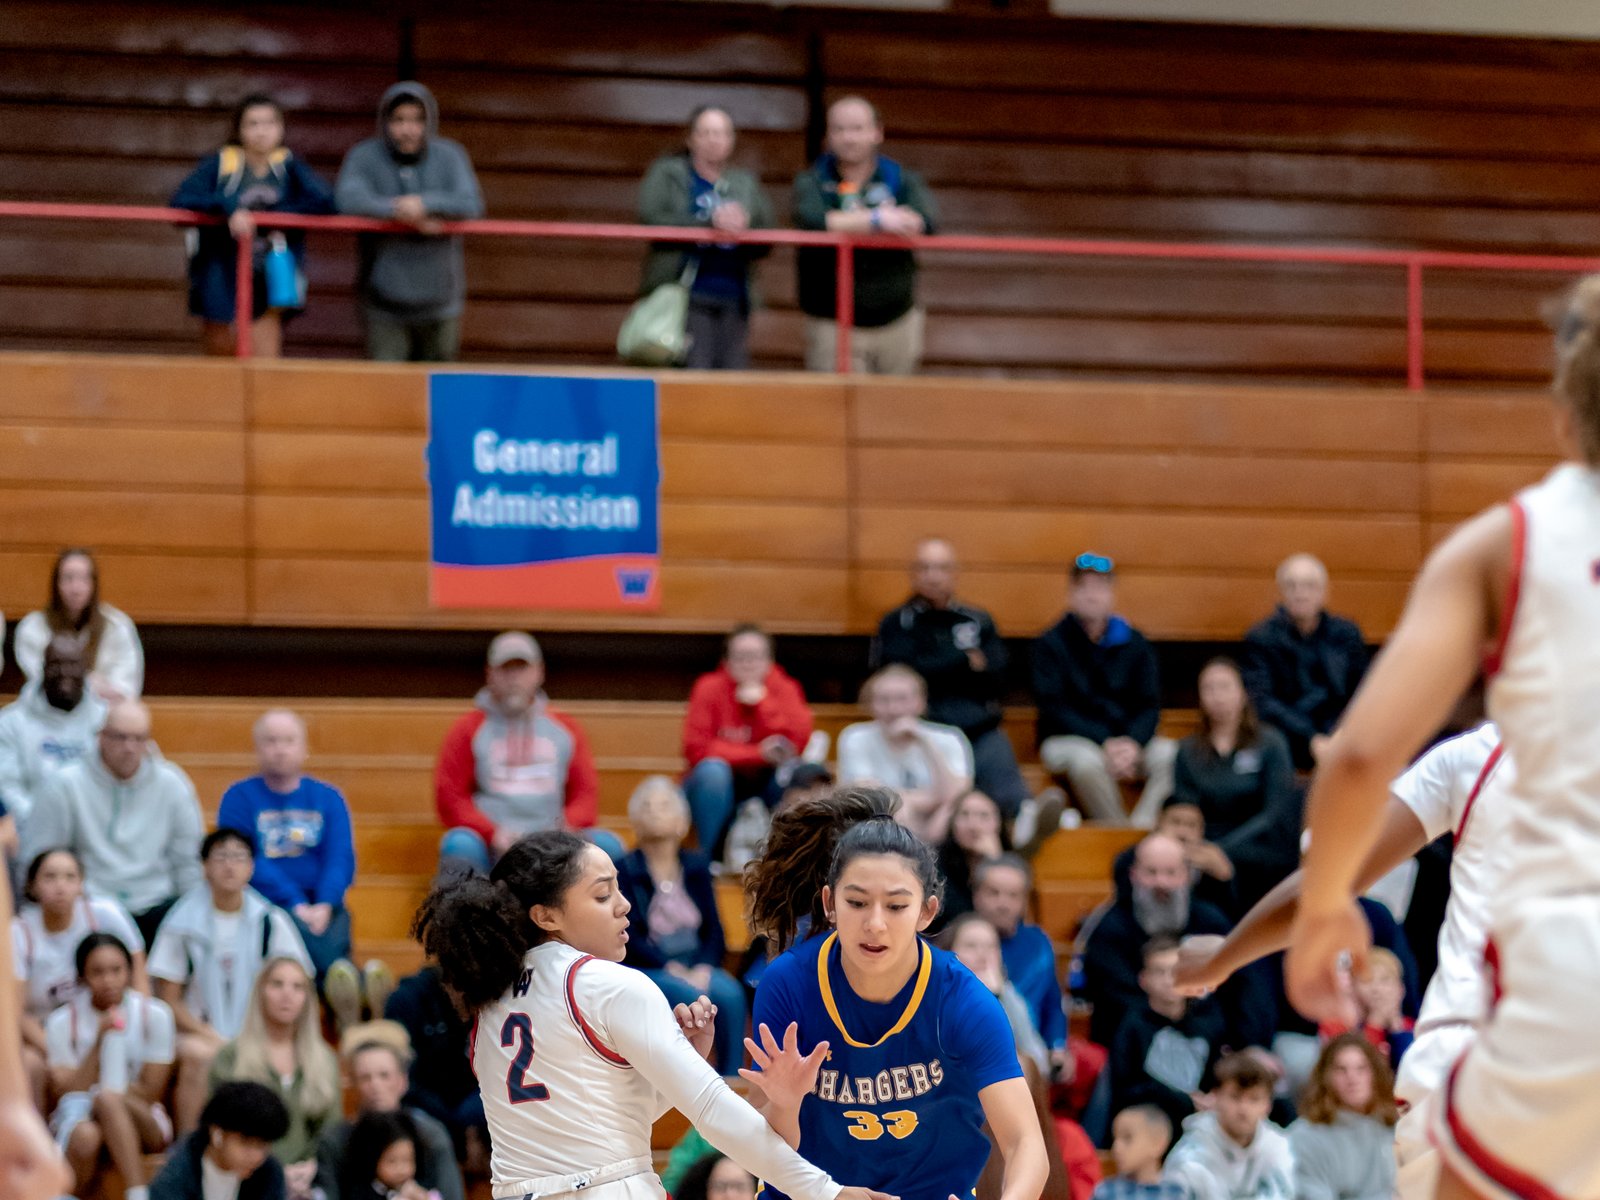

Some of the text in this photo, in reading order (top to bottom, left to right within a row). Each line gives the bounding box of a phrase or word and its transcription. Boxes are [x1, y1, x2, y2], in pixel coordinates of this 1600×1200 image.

[473, 429, 618, 476] General
[452, 482, 640, 530] Admission
[500, 1012, 550, 1105] 2
[812, 1058, 944, 1105] HARGERS
[843, 1109, 919, 1140] 33
